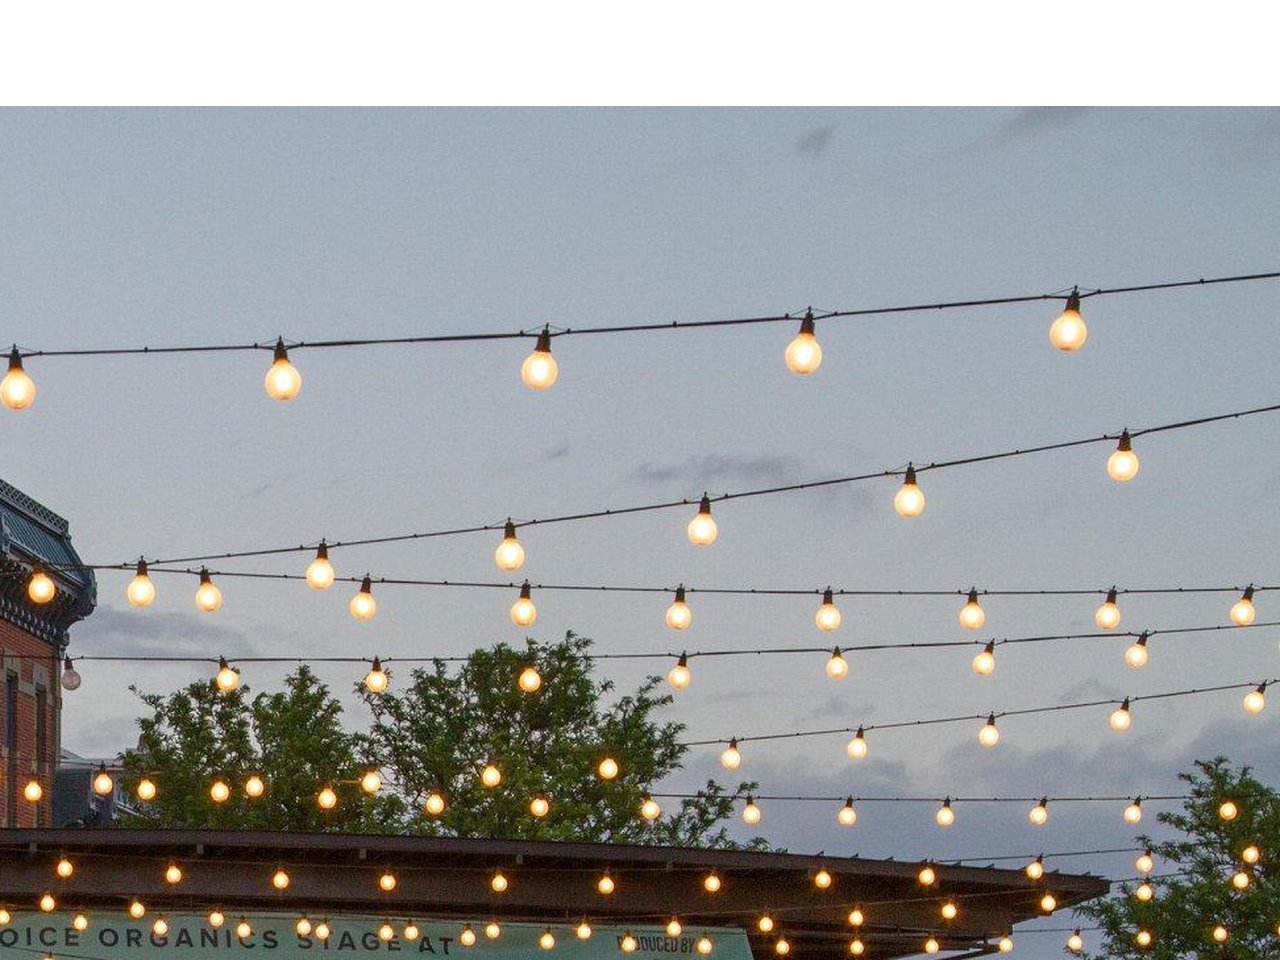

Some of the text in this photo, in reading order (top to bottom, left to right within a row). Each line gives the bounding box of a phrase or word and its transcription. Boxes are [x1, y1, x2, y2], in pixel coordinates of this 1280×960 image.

[420, 936, 454, 955] AT
[617, 935, 696, 954] ODUCED BY
